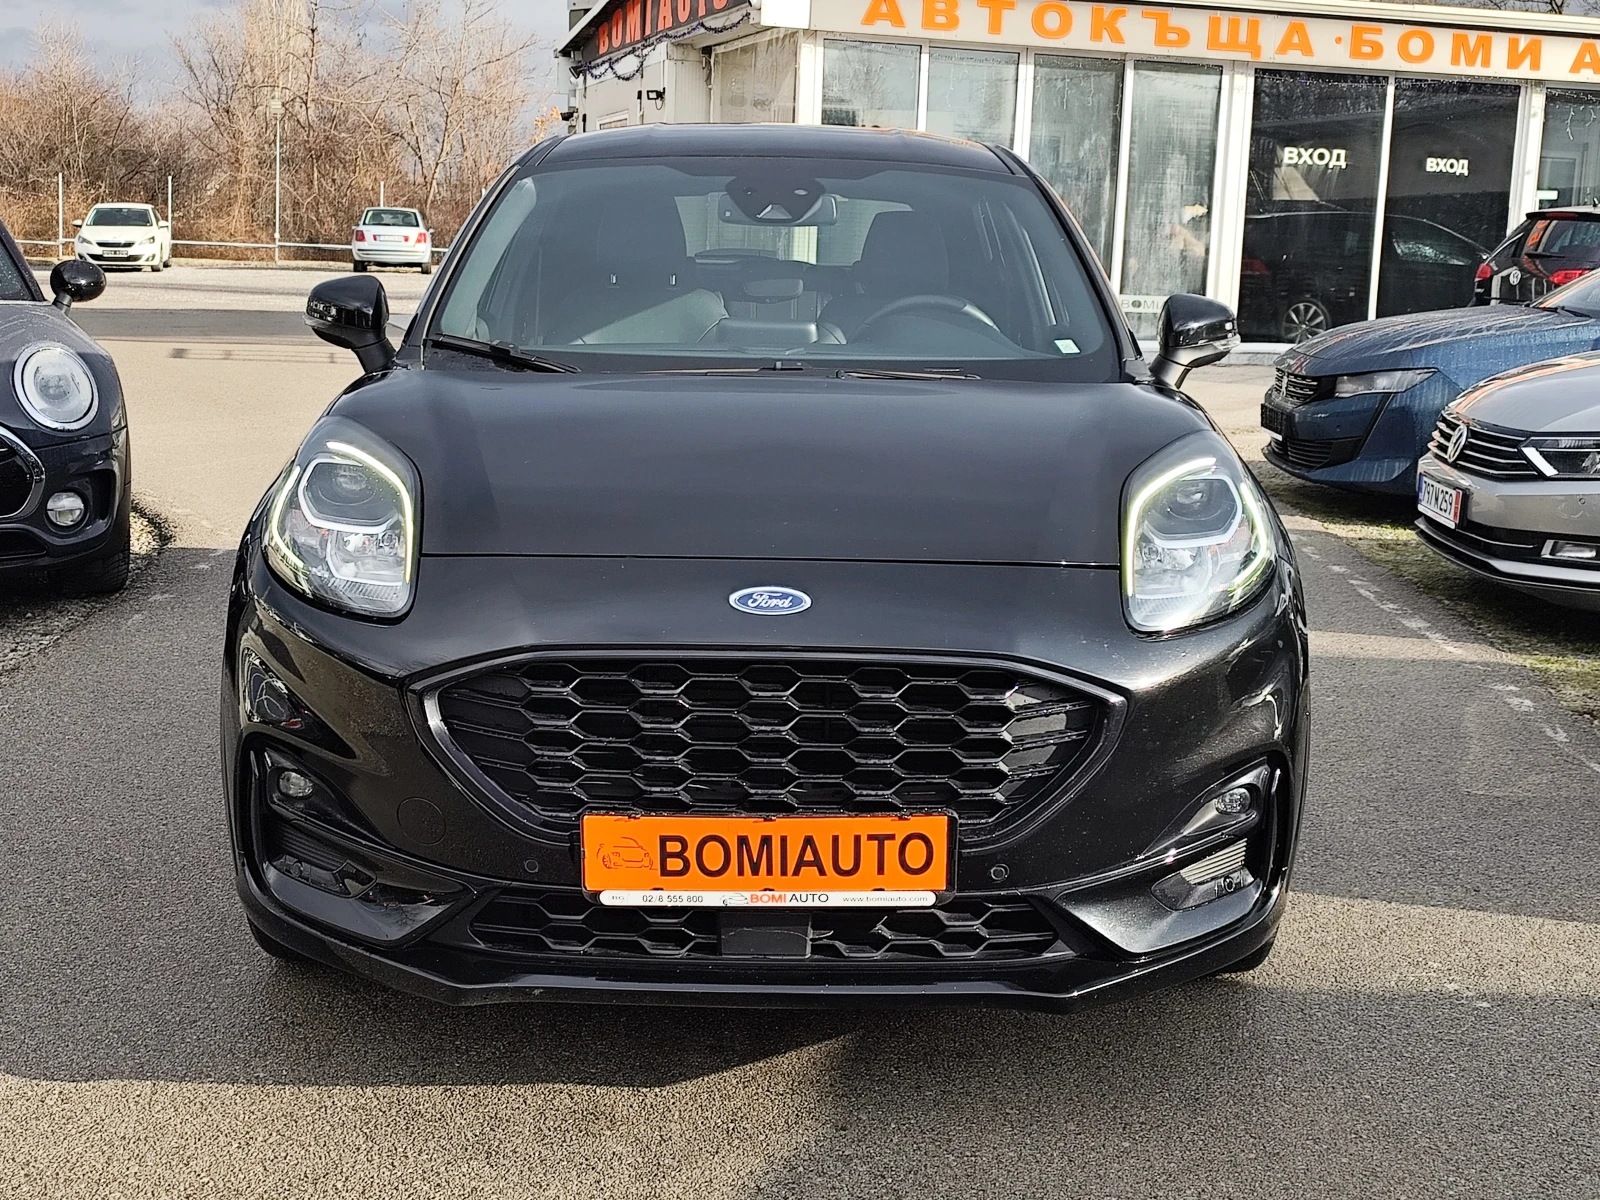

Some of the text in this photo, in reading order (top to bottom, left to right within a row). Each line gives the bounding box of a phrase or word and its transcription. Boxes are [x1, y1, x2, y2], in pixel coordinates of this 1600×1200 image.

[598, 0, 728, 55] BOMIA
[860, 0, 1314, 60] АВТОКЪЩА
[1283, 146, 1348, 170] ВХОД
[1426, 157, 1470, 177] ВХОД
[747, 592, 793, 608] Ford
[658, 833, 935, 878] BOMIAUTO
[642, 894, 664, 904] 02/8
[667, 894, 684, 904] 555
[686, 894, 704, 904] 800
[750, 893, 787, 904] BOMI
[789, 893, 829, 903] AUTO
